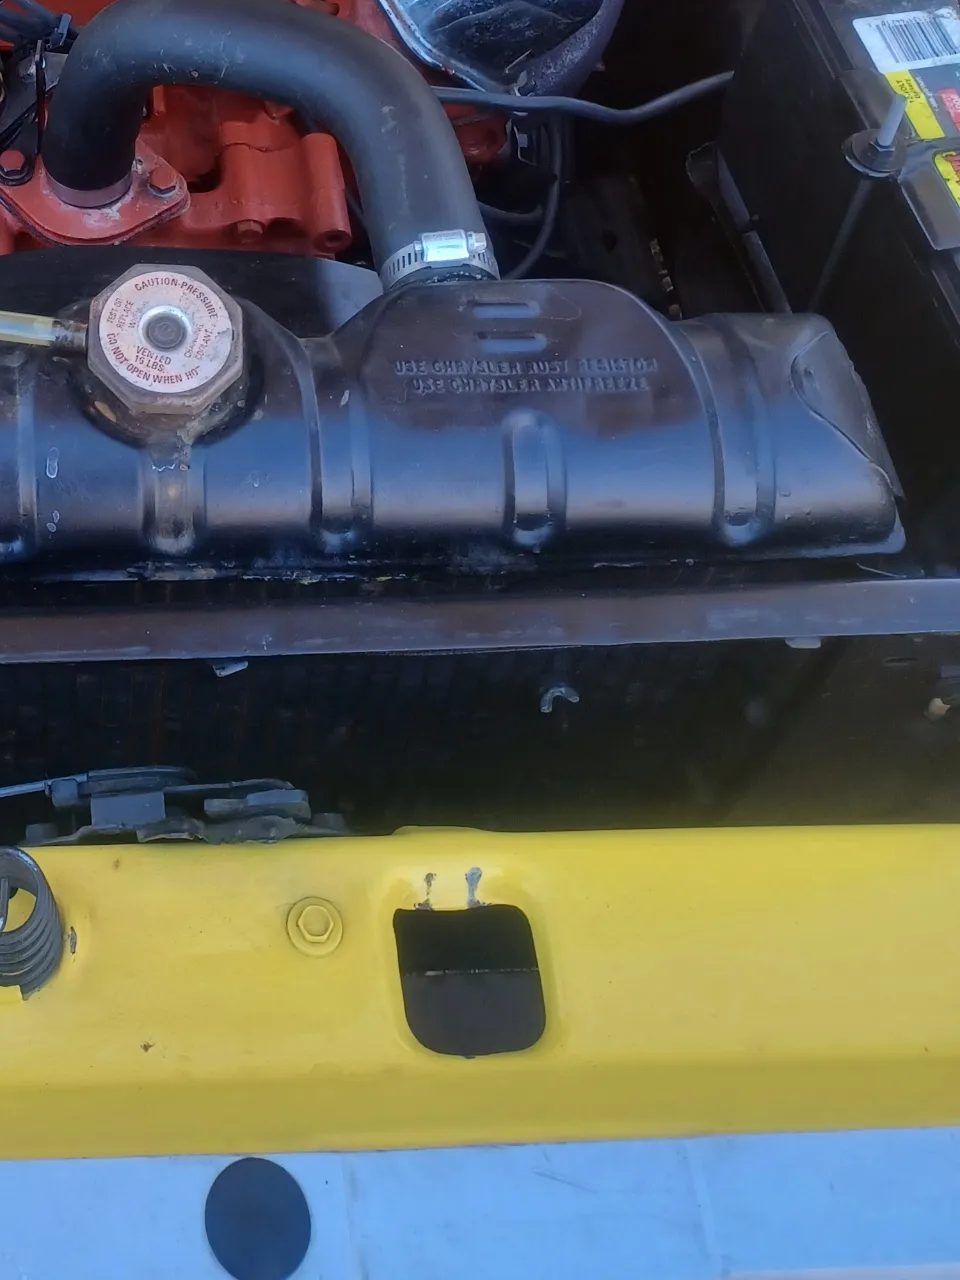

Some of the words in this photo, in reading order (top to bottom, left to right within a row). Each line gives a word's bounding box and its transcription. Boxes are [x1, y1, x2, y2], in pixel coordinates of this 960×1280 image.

[116, 300, 135, 331] REPLACE
[111, 346, 128, 364] NOT
[126, 363, 151, 381] OPEN
[152, 373, 183, 385] WHEN
[431, 358, 521, 377] CHRYSLER
[450, 377, 542, 395] CHRYSLER
